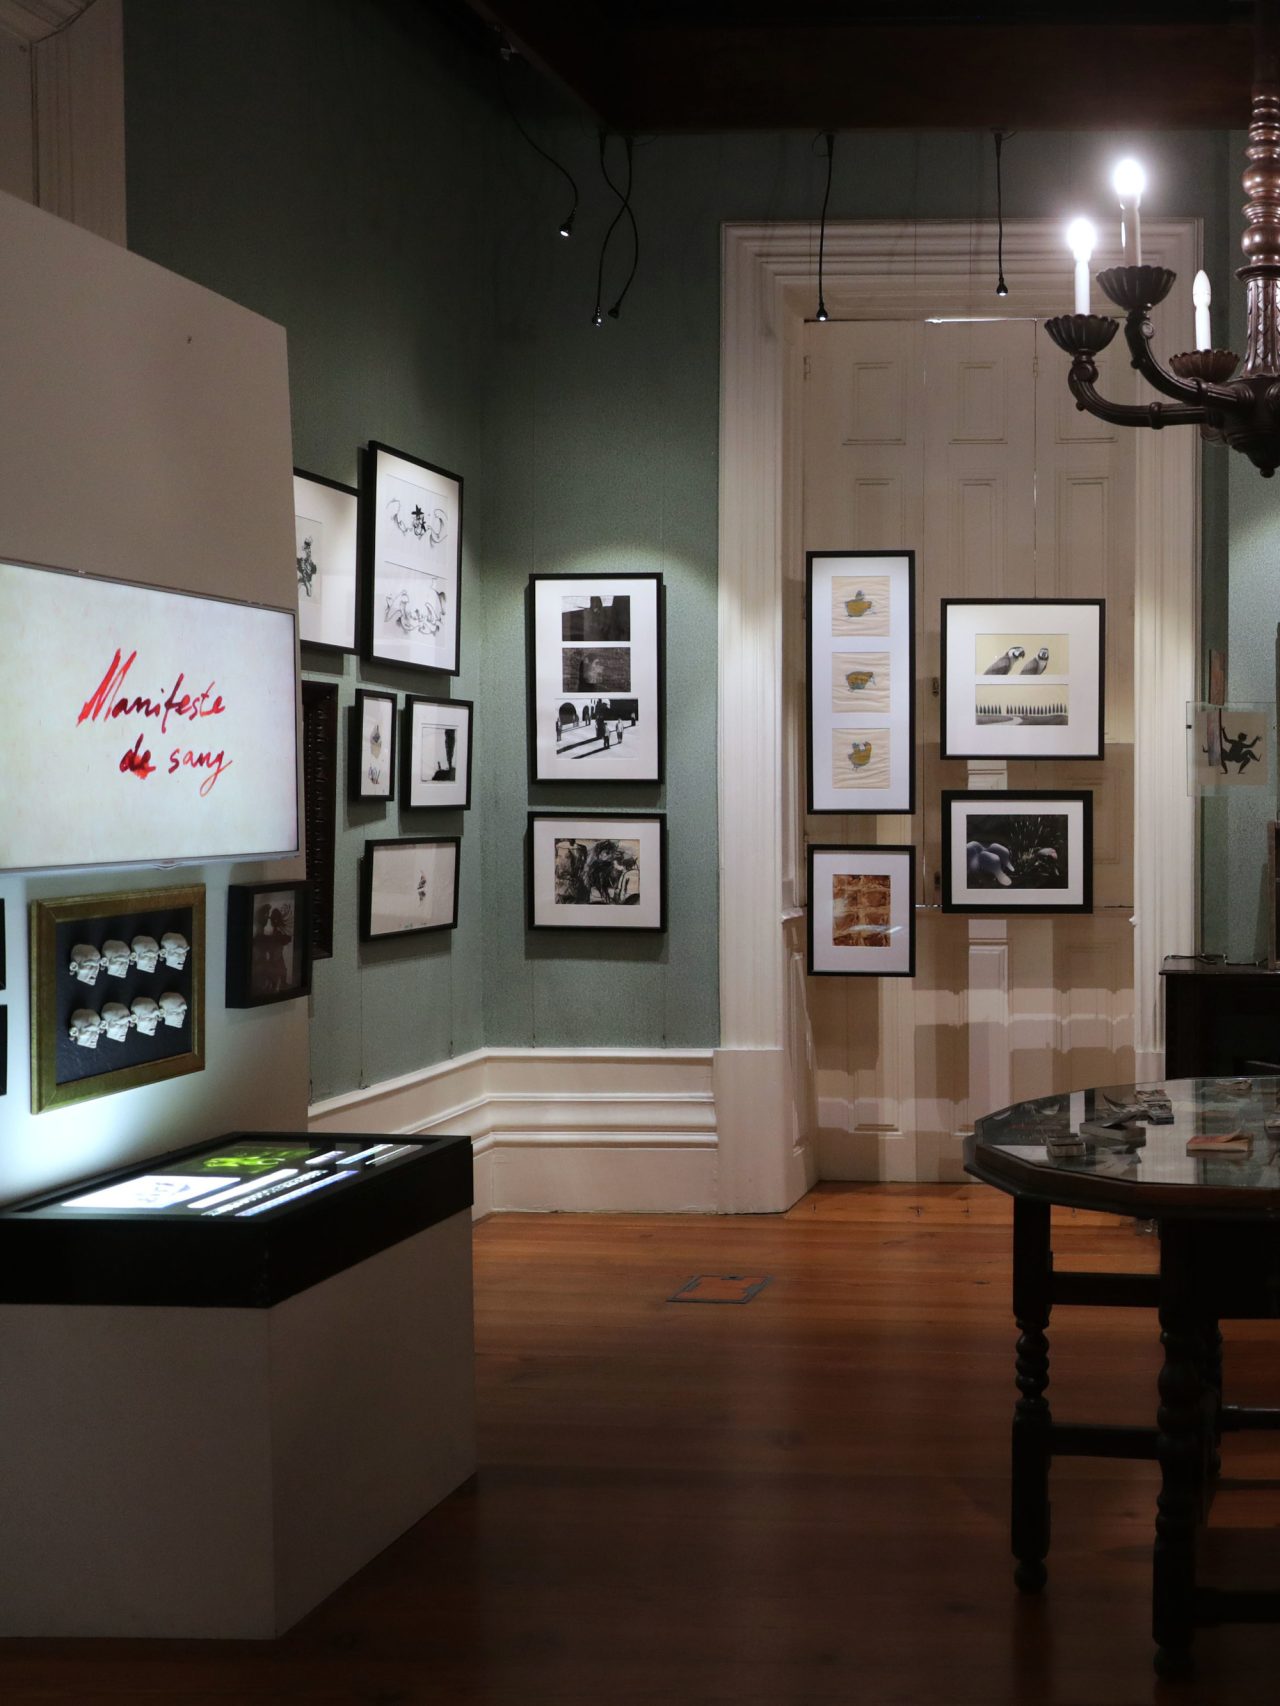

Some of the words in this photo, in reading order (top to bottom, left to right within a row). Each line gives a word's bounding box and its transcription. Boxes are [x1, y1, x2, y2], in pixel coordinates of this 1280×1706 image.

[76, 648, 225, 734] Manifeste
[119, 733, 156, 780] de
[168, 748, 233, 798] sang
